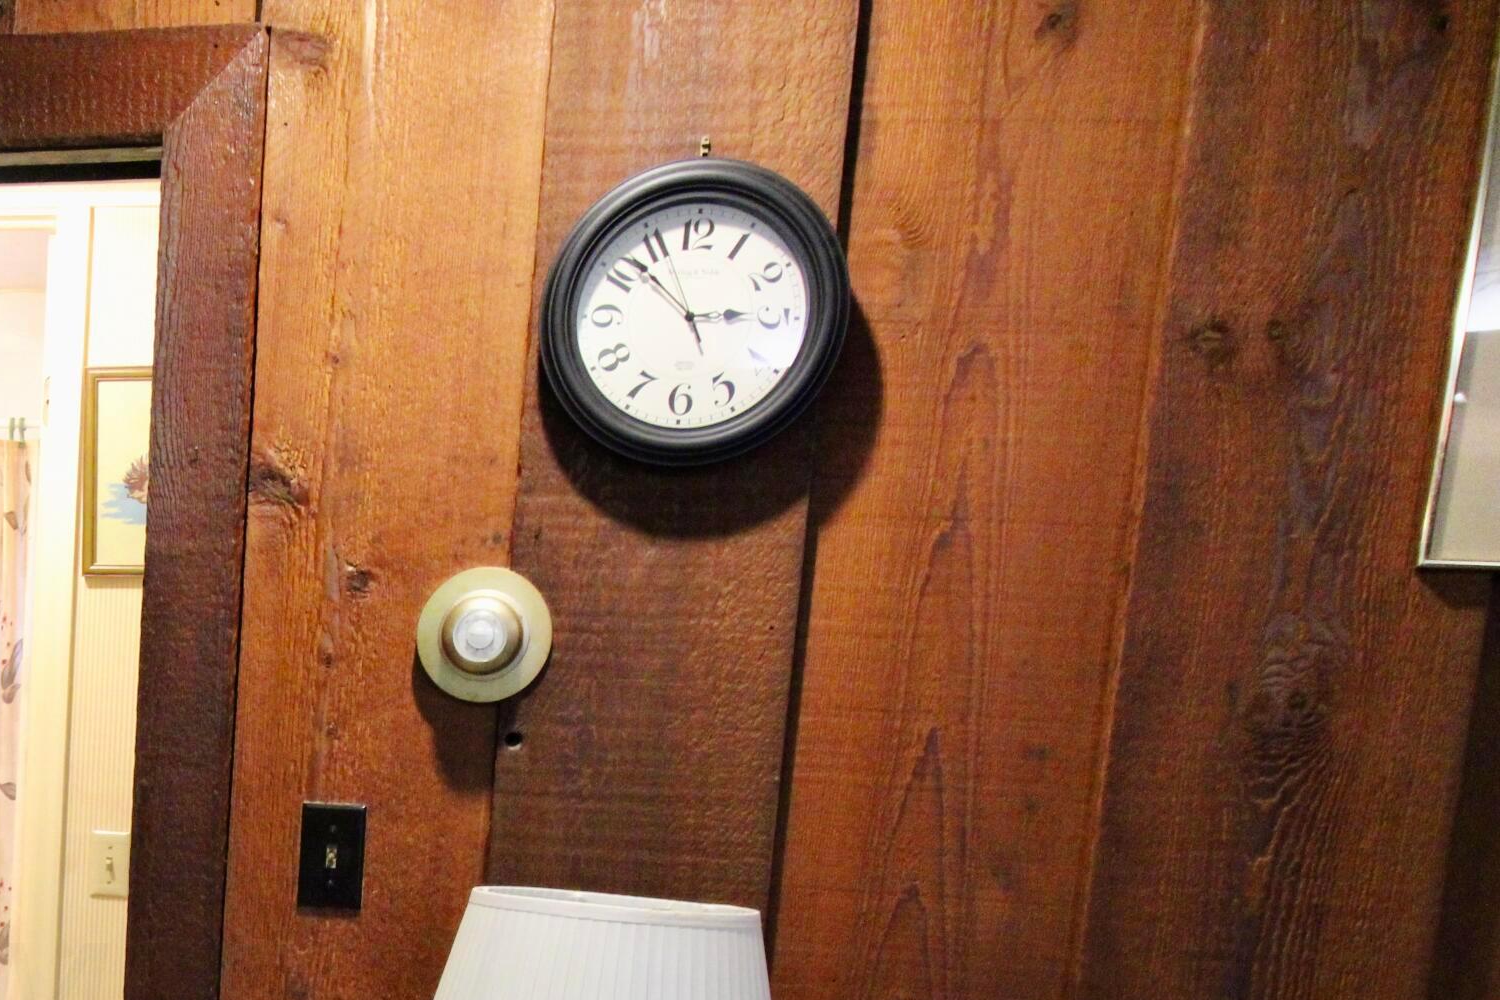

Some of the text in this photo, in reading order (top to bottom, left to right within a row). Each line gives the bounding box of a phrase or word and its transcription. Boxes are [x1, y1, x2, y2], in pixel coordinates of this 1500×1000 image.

[643, 226, 669, 264] 11
[682, 218, 715, 251] 12
[727, 233, 751, 260] 1
[606, 257, 643, 294] 10
[748, 262, 783, 291] 2
[591, 303, 623, 328] 9
[757, 305, 790, 330] 3
[598, 343, 630, 372] 8
[627, 370, 659, 400] 7
[668, 383, 693, 416] 6
[712, 371, 735, 407] 5
